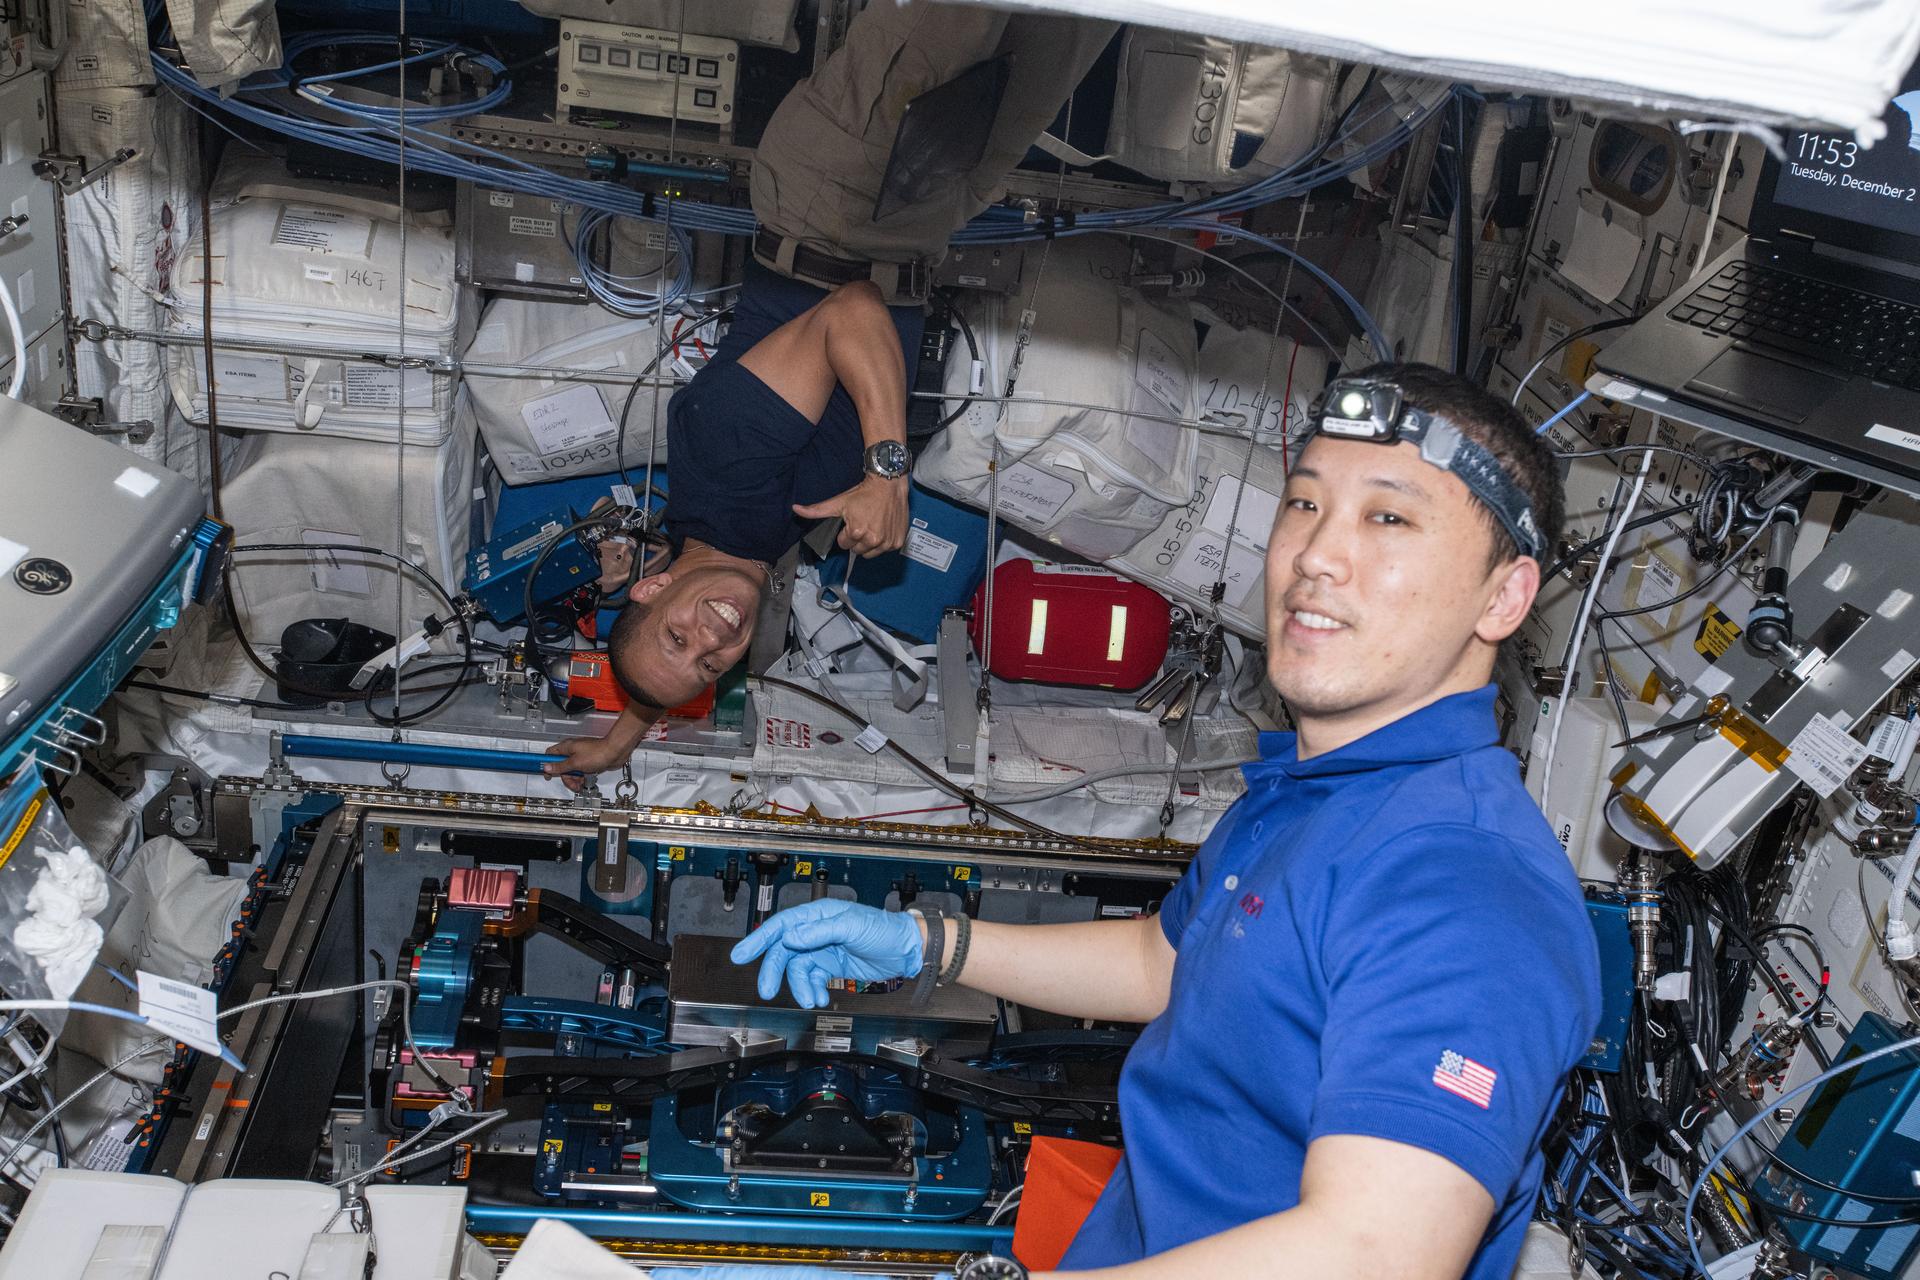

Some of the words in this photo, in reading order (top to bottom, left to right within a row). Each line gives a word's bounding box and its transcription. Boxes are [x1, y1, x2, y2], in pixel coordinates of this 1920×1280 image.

[621, 31, 642, 39] CAUTION
[1192, 62, 1226, 145] 4309
[1798, 132, 1858, 168] 11:53
[1791, 162, 1837, 186] Tuesday,
[1841, 174, 1904, 199] December
[344, 269, 386, 291] 1467
[1550, 430, 1578, 454] DRAWER
[1200, 544, 1223, 558] ESA
[1228, 572, 1240, 583] 2
[1868, 855, 1895, 879] ACILITY
